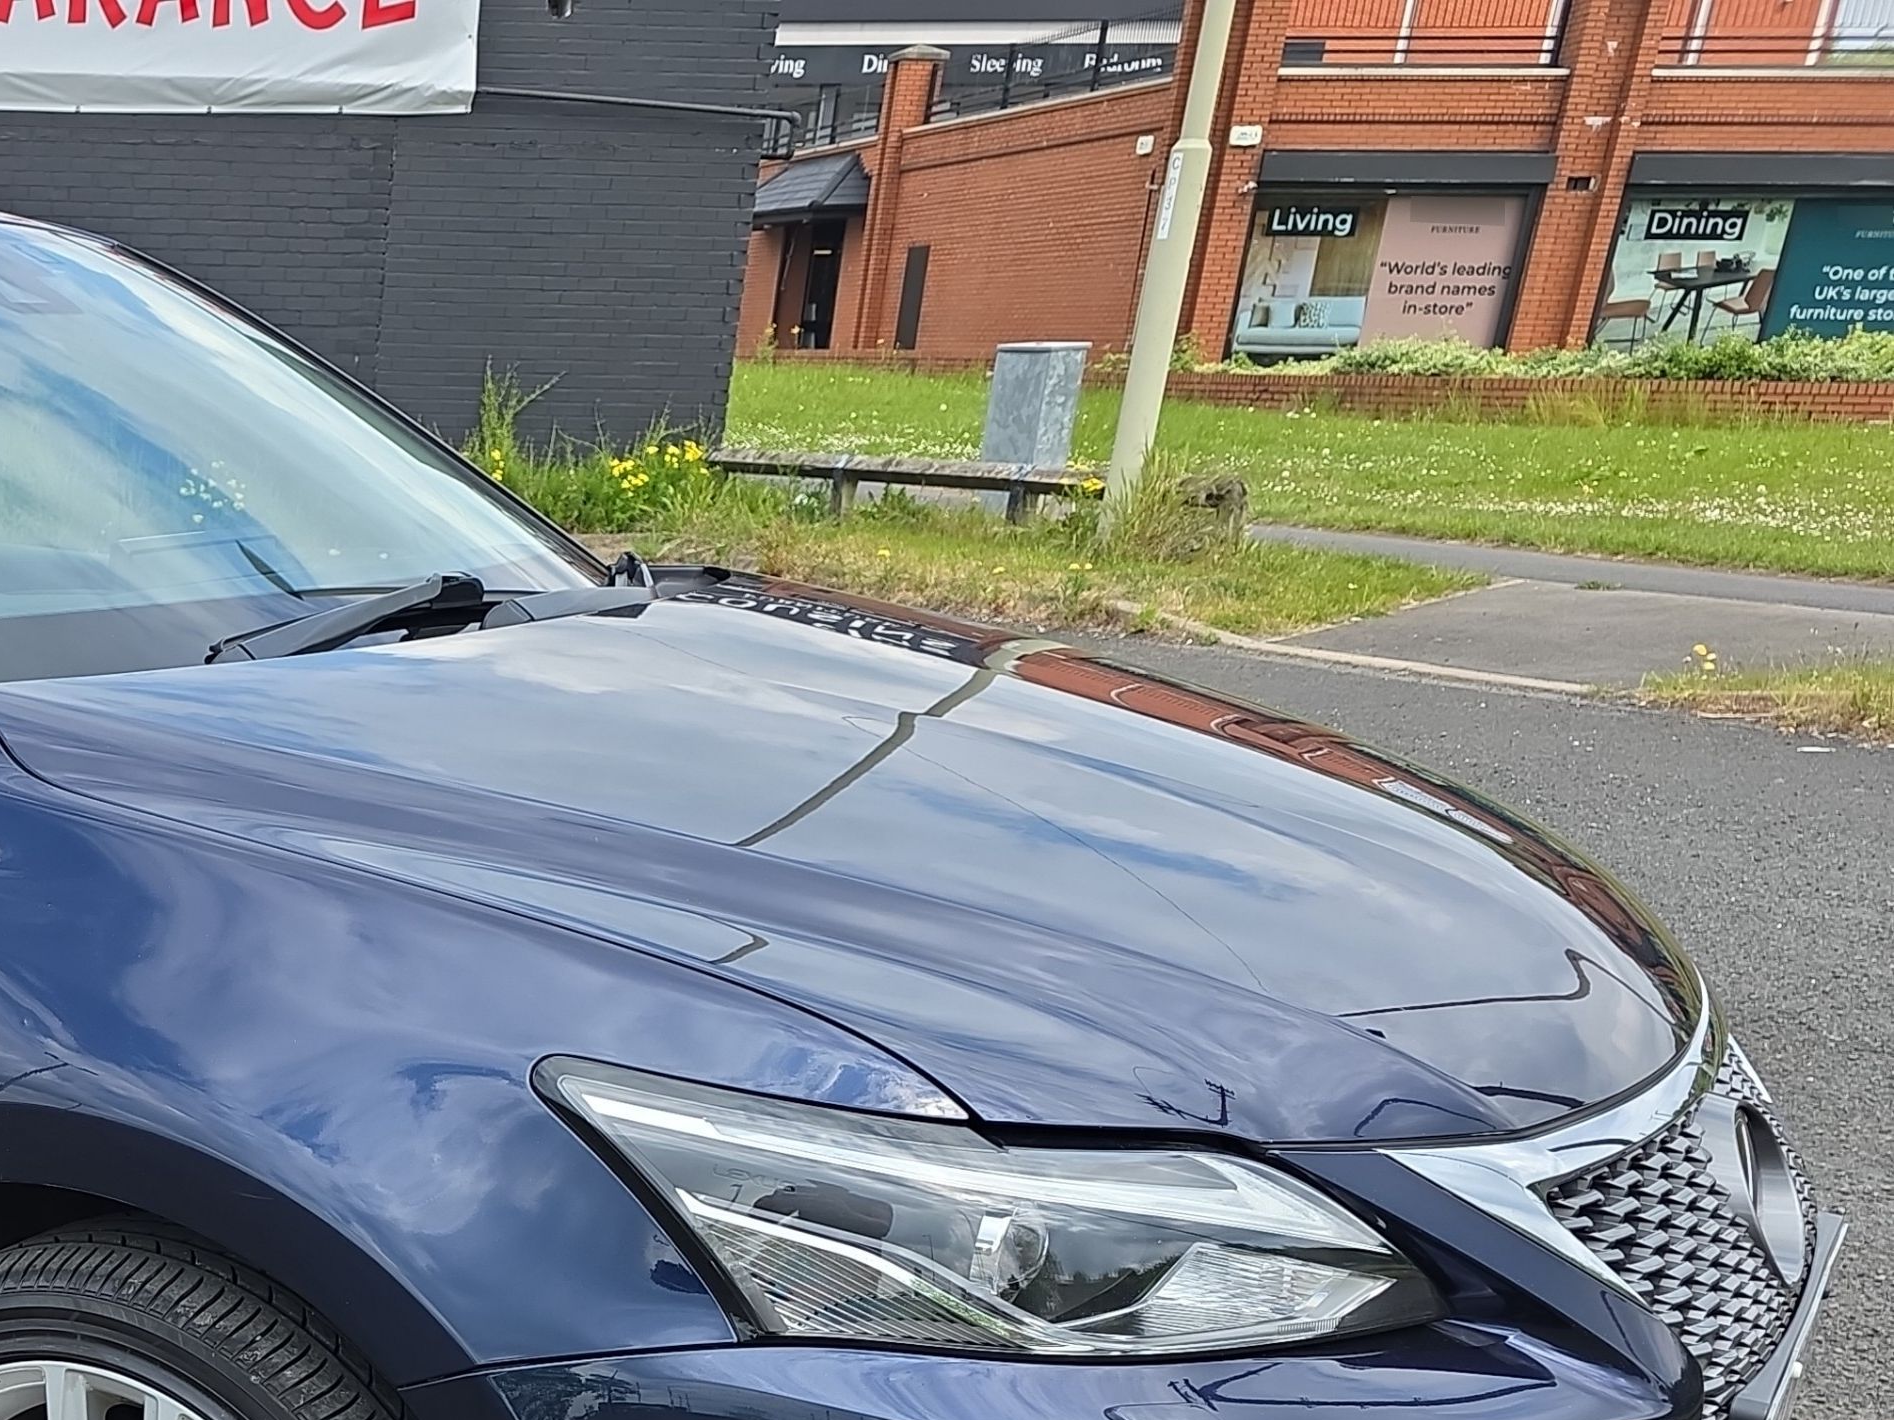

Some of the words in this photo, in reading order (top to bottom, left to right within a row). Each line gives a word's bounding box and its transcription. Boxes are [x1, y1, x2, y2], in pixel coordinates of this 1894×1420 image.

[969, 53, 1045, 77] Sleeing
[1271, 206, 1354, 237] Living
[1430, 225, 1482, 234] FURNITURE
[1650, 210, 1744, 240] Dining
[1452, 261, 1512, 280] leading
[1867, 265, 1890, 281] of
[1387, 281, 1437, 296] brand
[1440, 284, 1497, 297] names
[1814, 285, 1853, 301] UK's
[1401, 300, 1474, 316] in-store”
[1789, 304, 1865, 321] furniture
